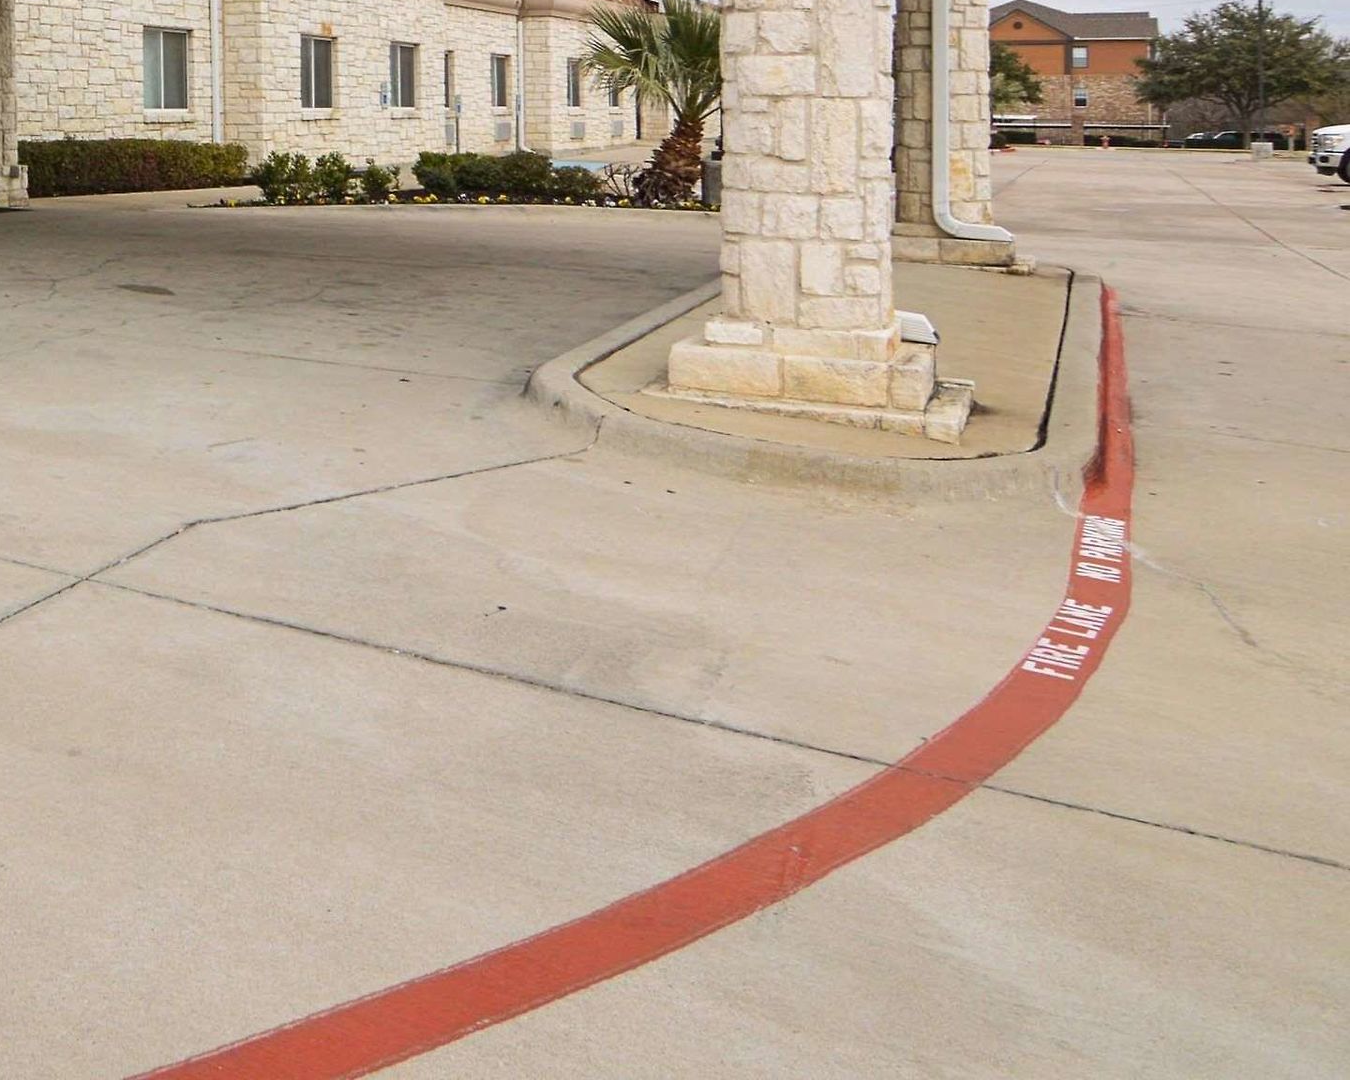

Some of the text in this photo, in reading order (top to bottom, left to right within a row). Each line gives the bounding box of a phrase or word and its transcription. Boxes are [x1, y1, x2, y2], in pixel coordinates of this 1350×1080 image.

[1021, 515, 1127, 680] FIRE LANE NO PARKING
